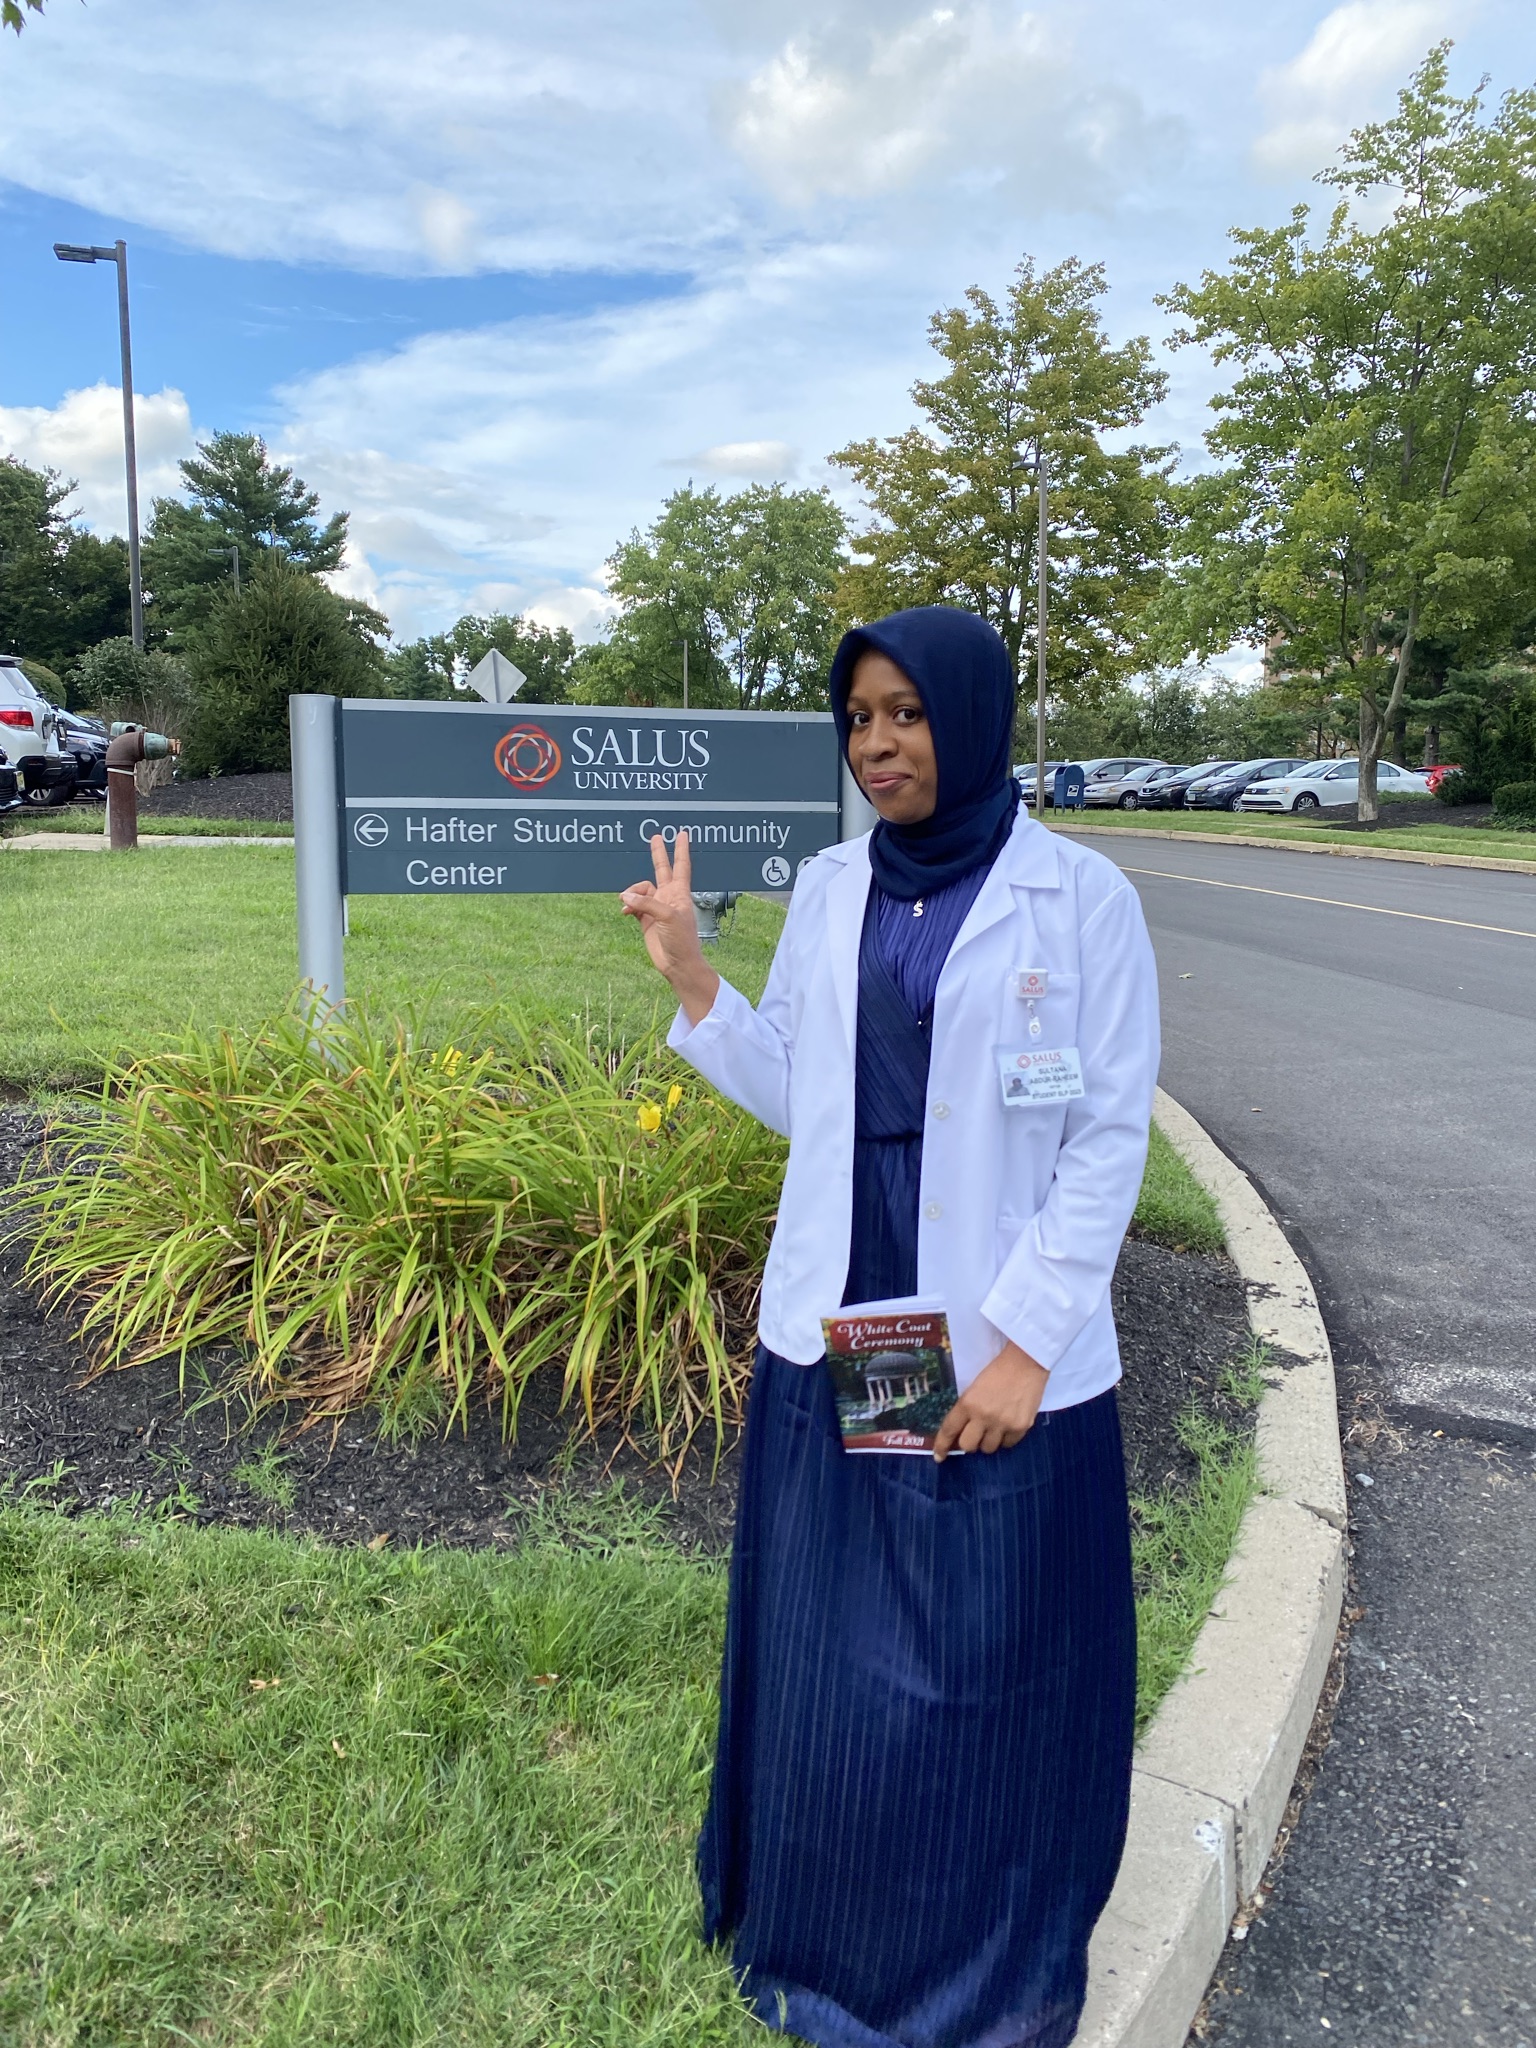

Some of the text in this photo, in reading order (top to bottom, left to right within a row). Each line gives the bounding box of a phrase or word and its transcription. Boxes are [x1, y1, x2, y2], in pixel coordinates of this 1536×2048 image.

[571, 727, 710, 767] SALUS
[574, 771, 708, 790] UNIVERSITY
[406, 817, 791, 849] Hafter Student Community
[406, 860, 508, 886] Center
[1032, 1052, 1062, 1062] SALUS
[837, 1319, 931, 1339] White Coat
[851, 1335, 925, 1350] Ceremony
